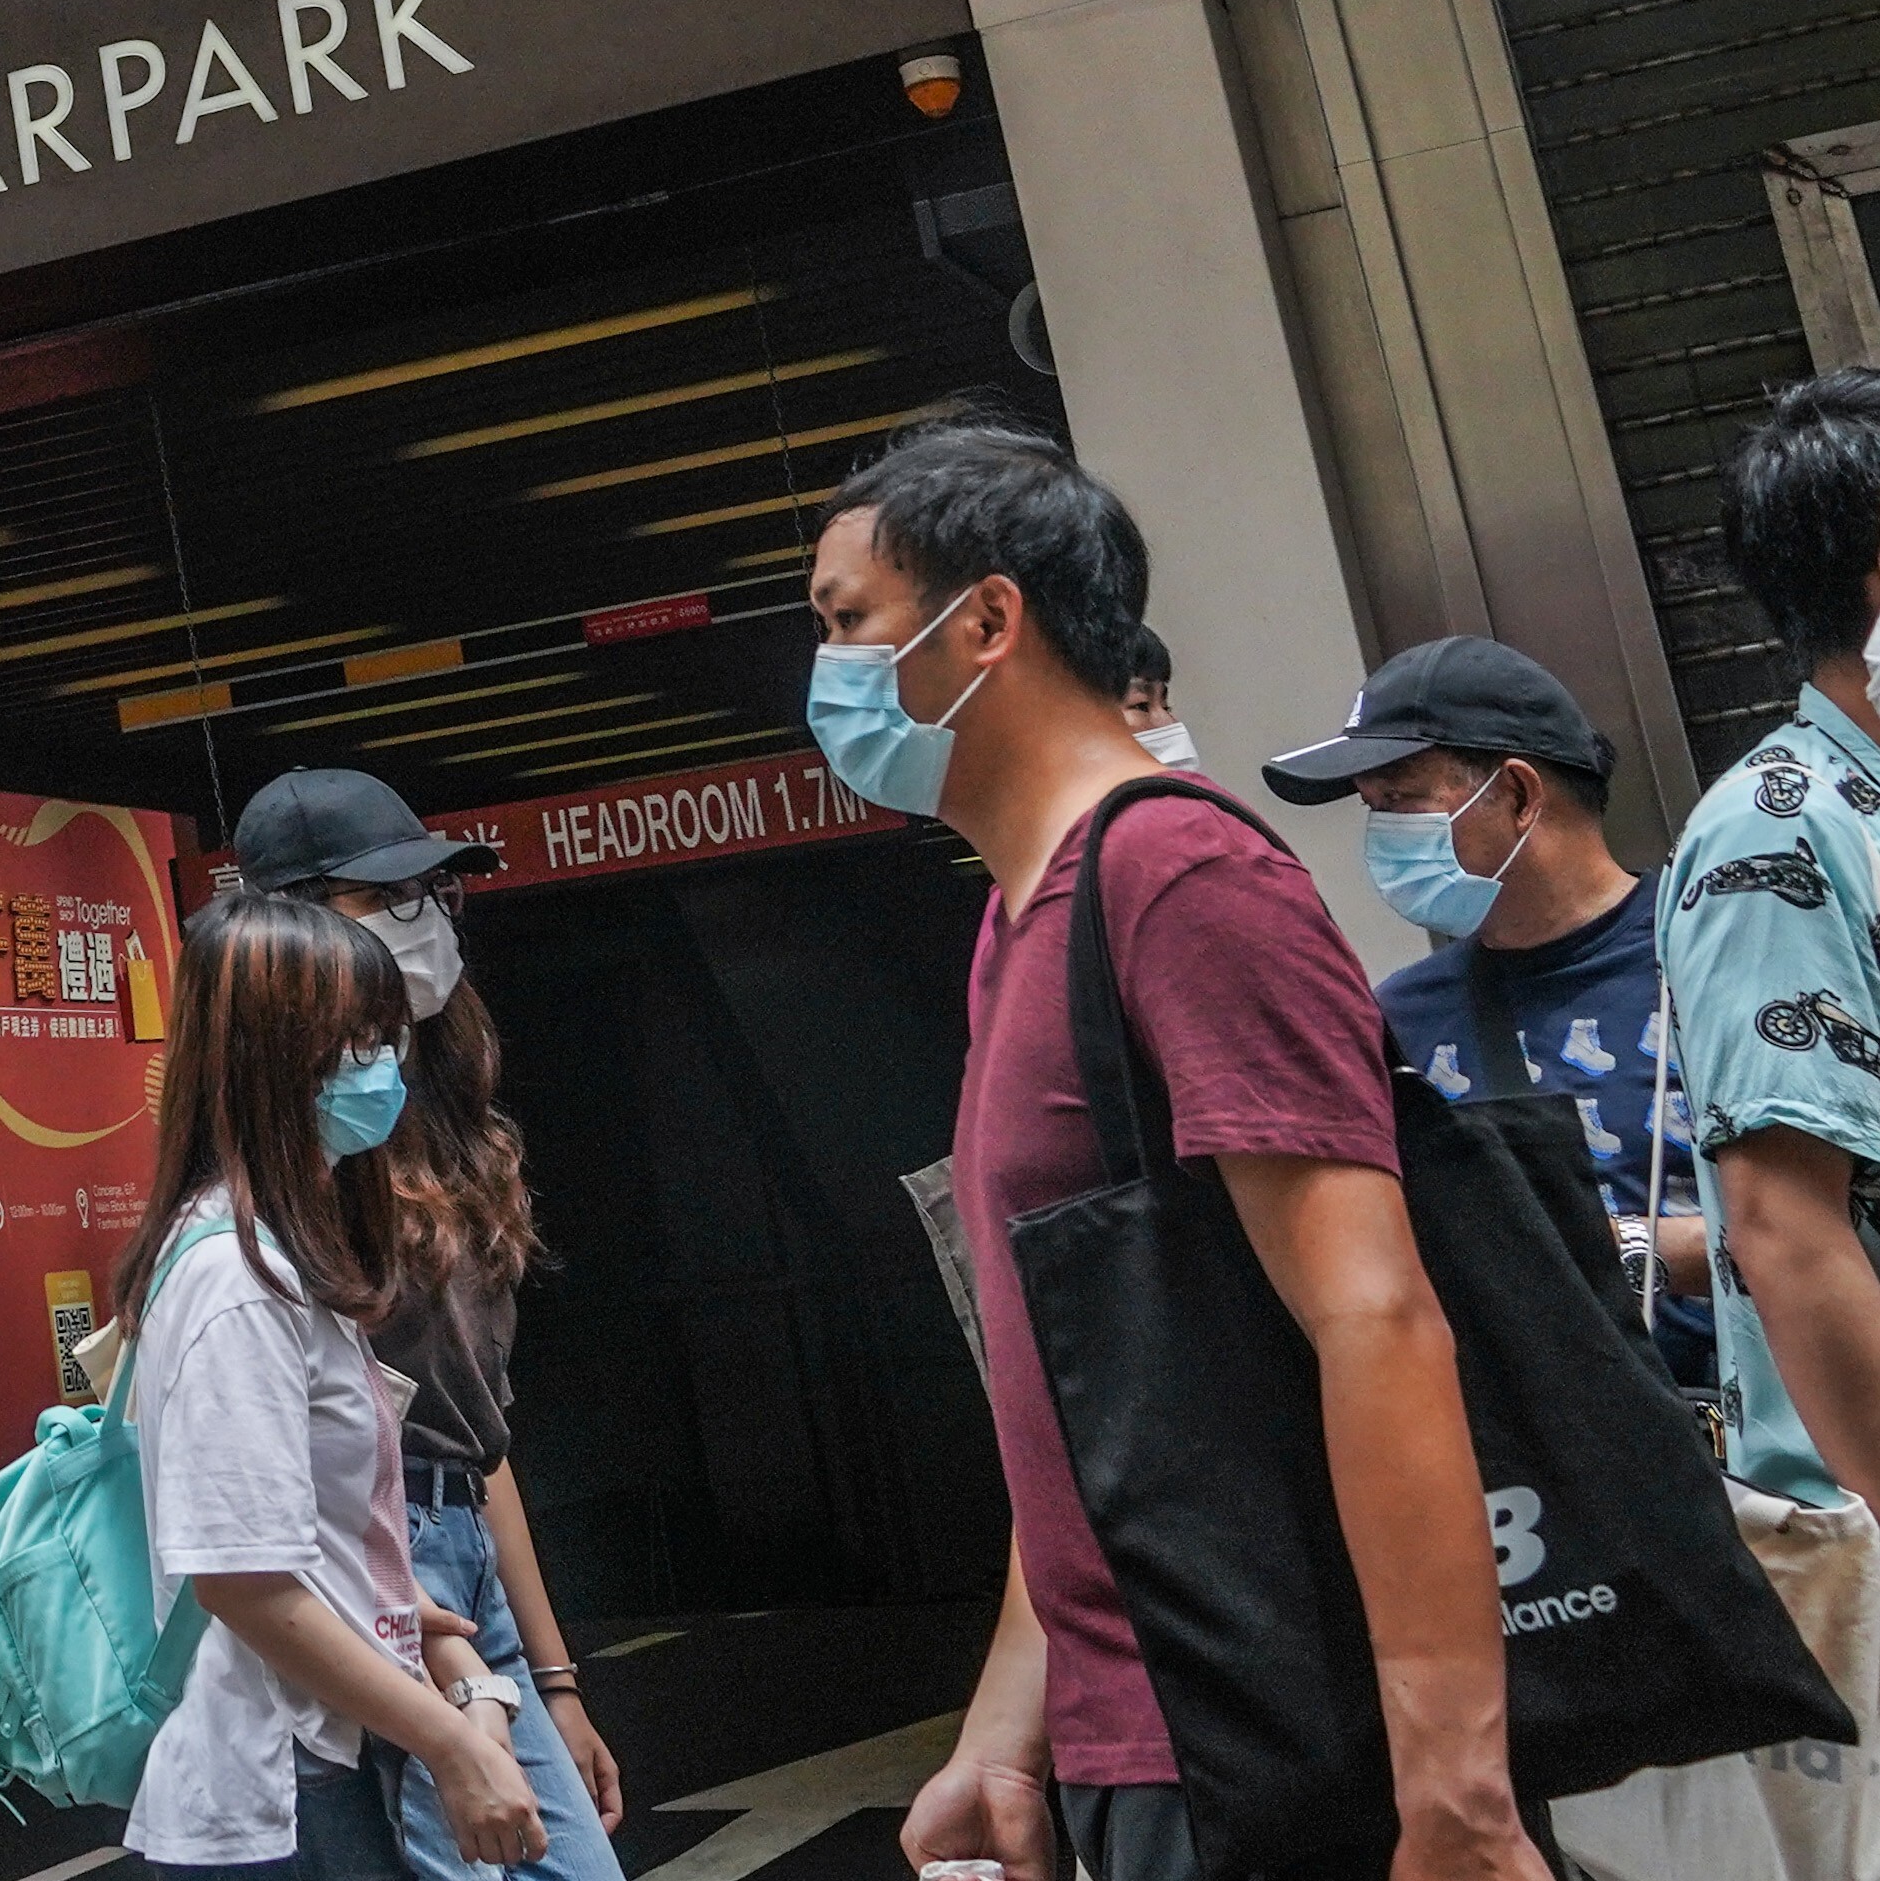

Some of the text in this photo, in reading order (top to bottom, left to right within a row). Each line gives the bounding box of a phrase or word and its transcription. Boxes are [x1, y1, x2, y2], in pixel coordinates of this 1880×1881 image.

[541, 775, 766, 869] HEADROOM
[75, 896, 131, 930] Together
[1501, 1584, 1618, 1637] lance
